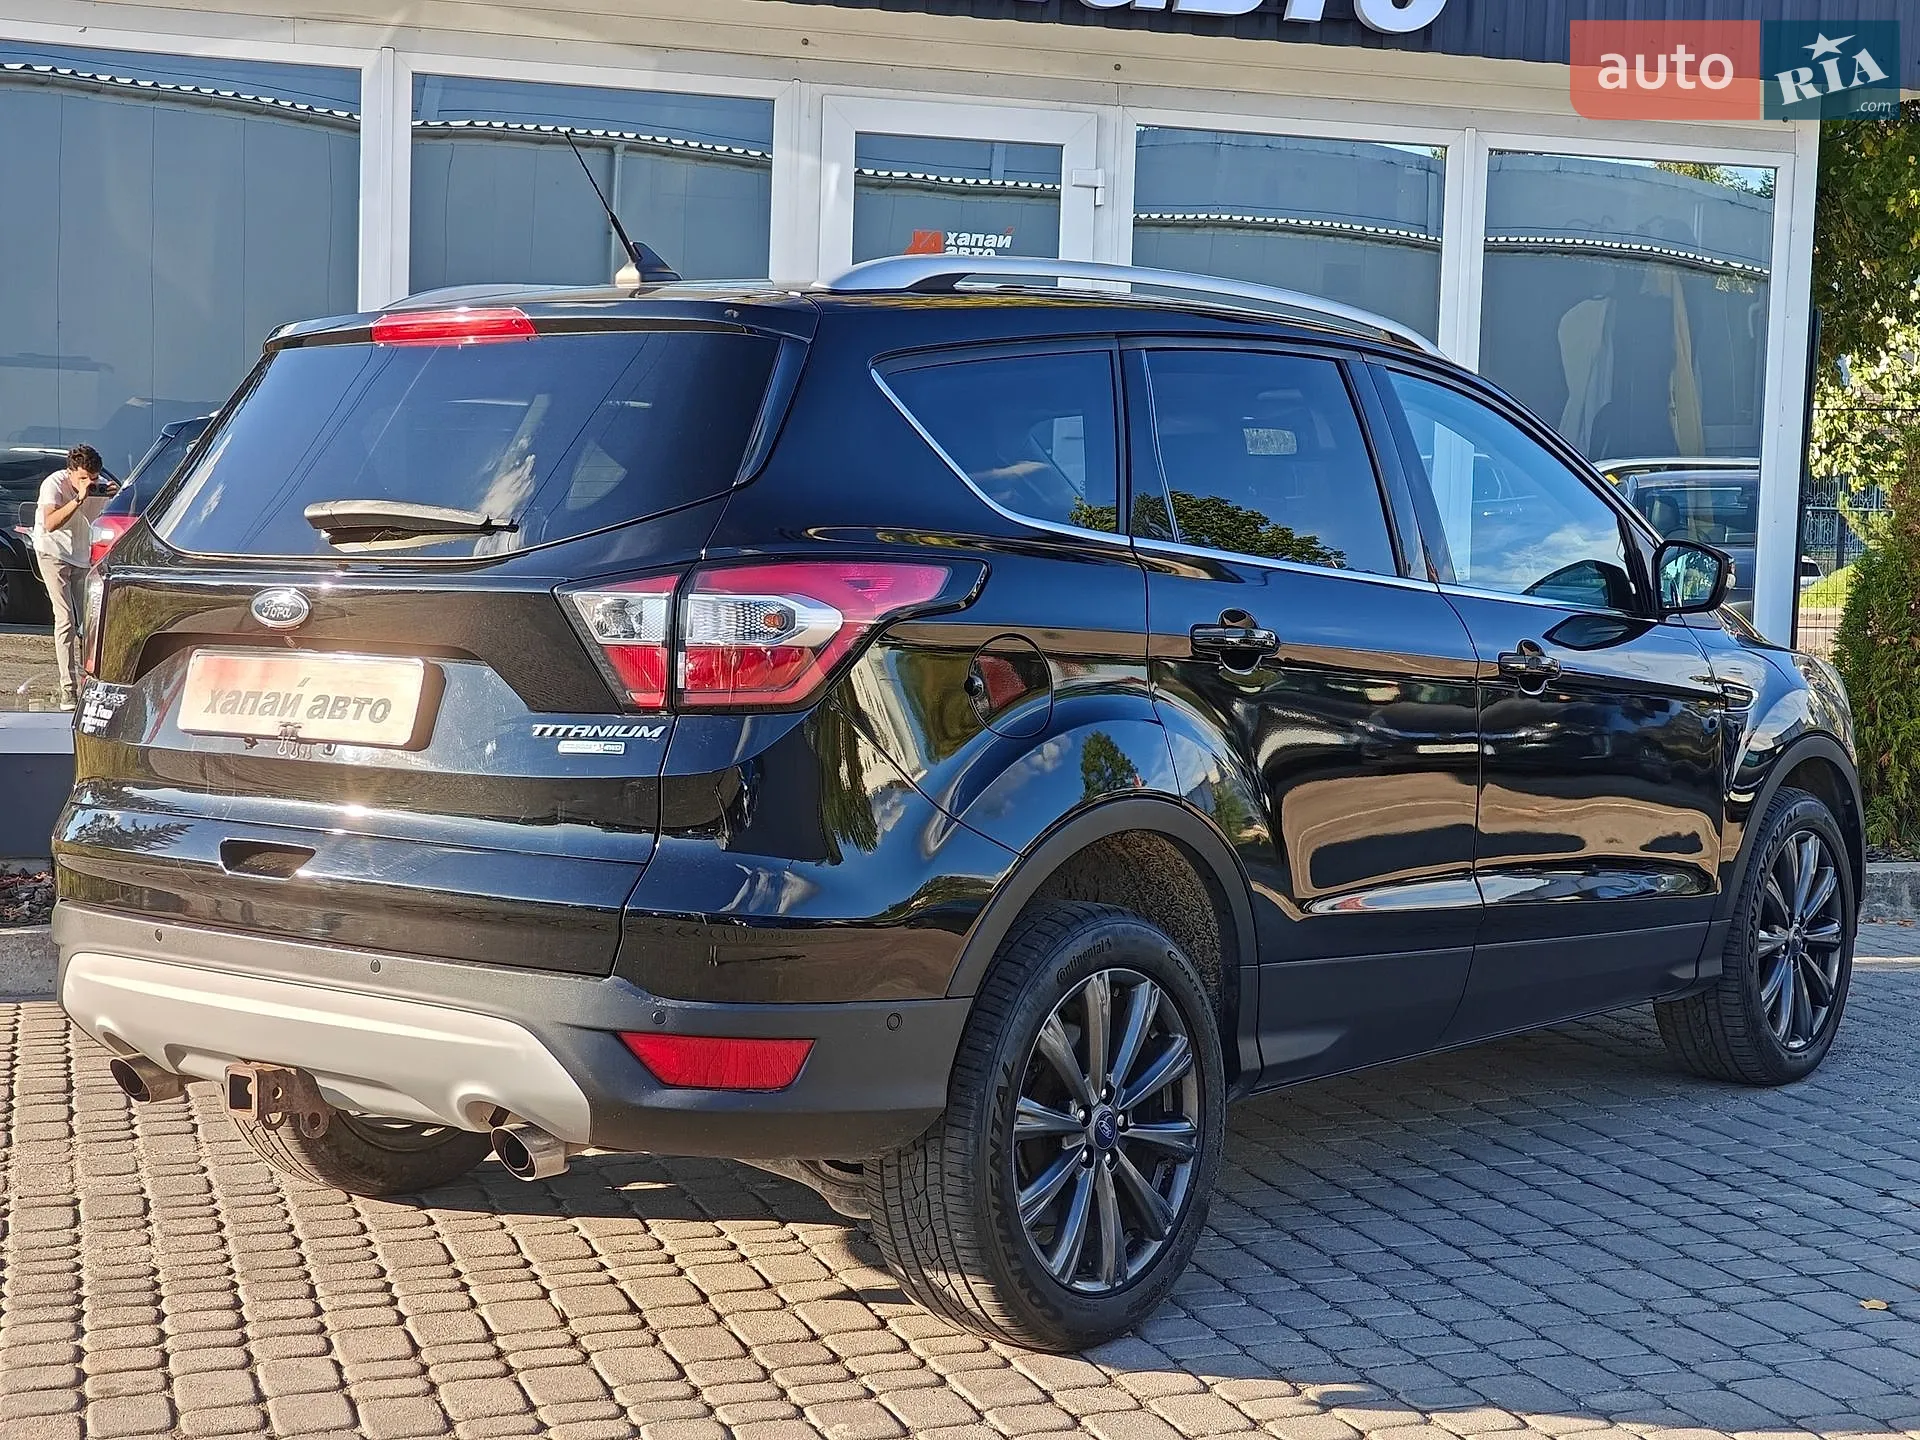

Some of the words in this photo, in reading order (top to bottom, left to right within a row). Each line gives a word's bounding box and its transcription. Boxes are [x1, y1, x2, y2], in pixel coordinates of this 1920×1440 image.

[306, 693, 392, 724] авто
[531, 723, 667, 739] TITANIUM
[1748, 807, 1801, 974] CONTINENTAL
[1056, 937, 1107, 984] Continental
